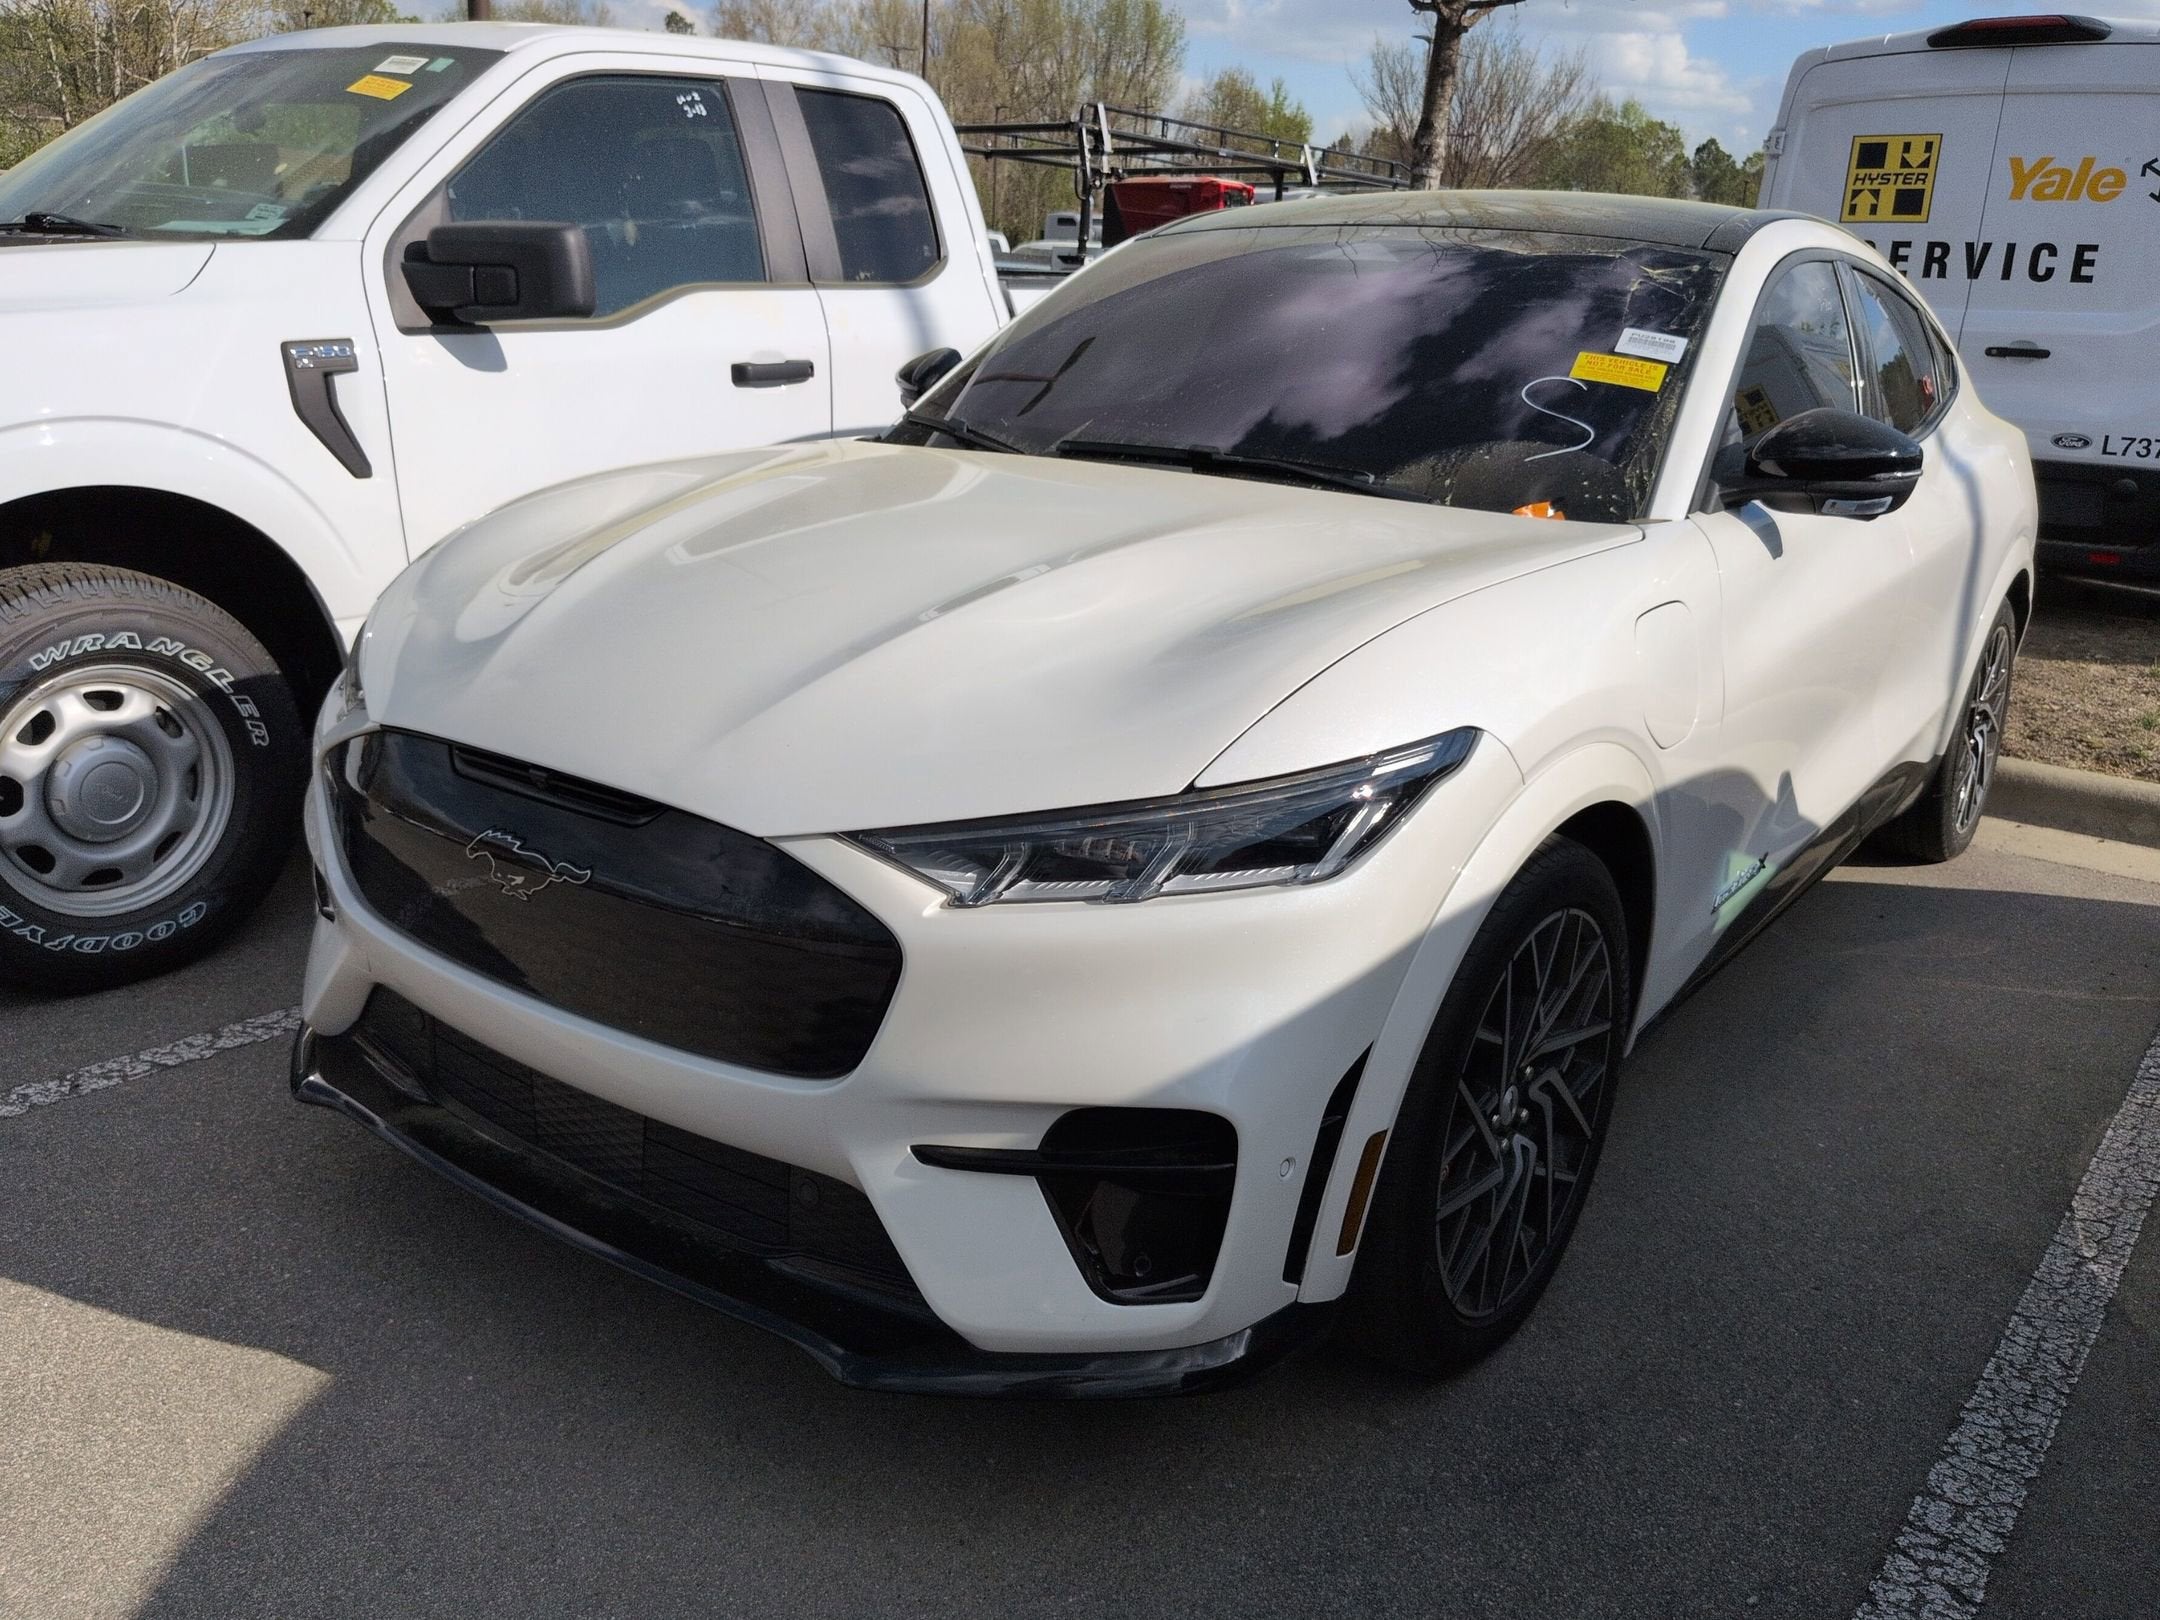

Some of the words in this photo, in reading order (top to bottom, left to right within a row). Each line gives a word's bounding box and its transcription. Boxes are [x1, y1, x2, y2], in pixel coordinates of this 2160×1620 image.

[1852, 172, 1929, 186] HYSTER
[2008, 155, 2129, 203] Yale
[1864, 239, 2100, 284] ERVICE
[1607, 357, 1647, 367] VEHICLE
[1628, 366, 1652, 375] SALE
[28, 631, 271, 748] WRANGLER
